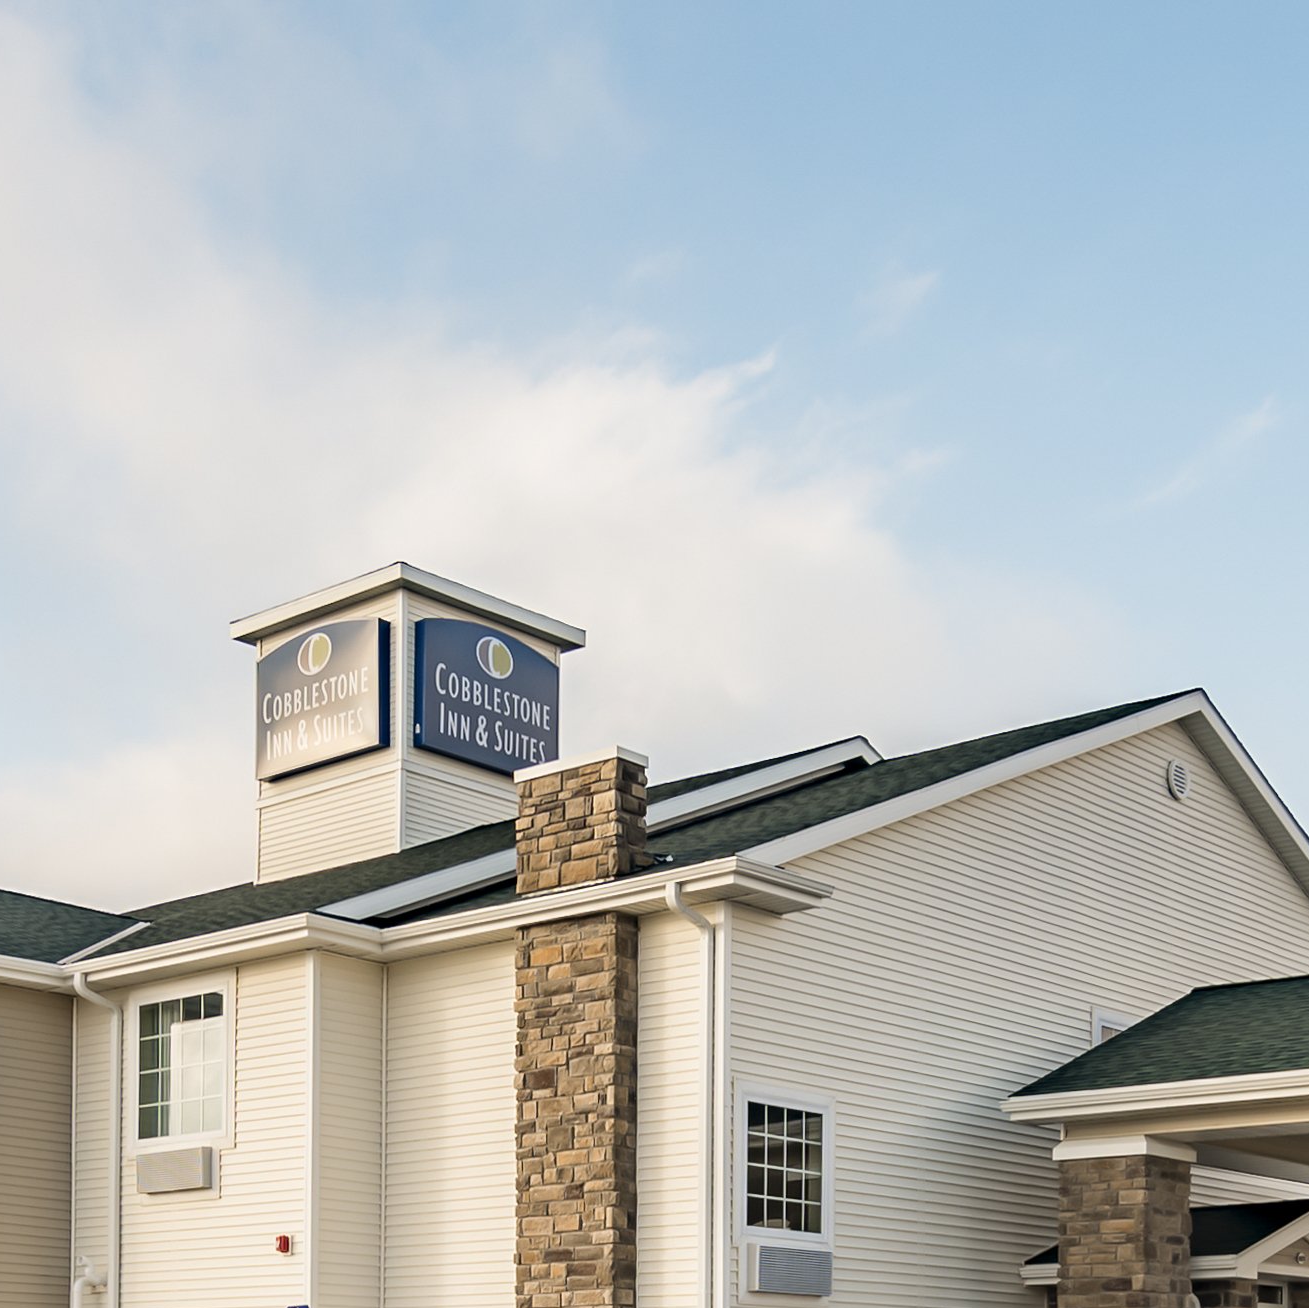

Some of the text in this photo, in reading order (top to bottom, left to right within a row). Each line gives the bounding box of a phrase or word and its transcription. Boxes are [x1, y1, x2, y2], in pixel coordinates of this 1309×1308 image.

[263, 666, 369, 724] COBBLESTONE
[435, 662, 551, 731] COBBLESTONE
[266, 706, 364, 761] INN & SUITES
[439, 701, 546, 765] INN & SUITES
